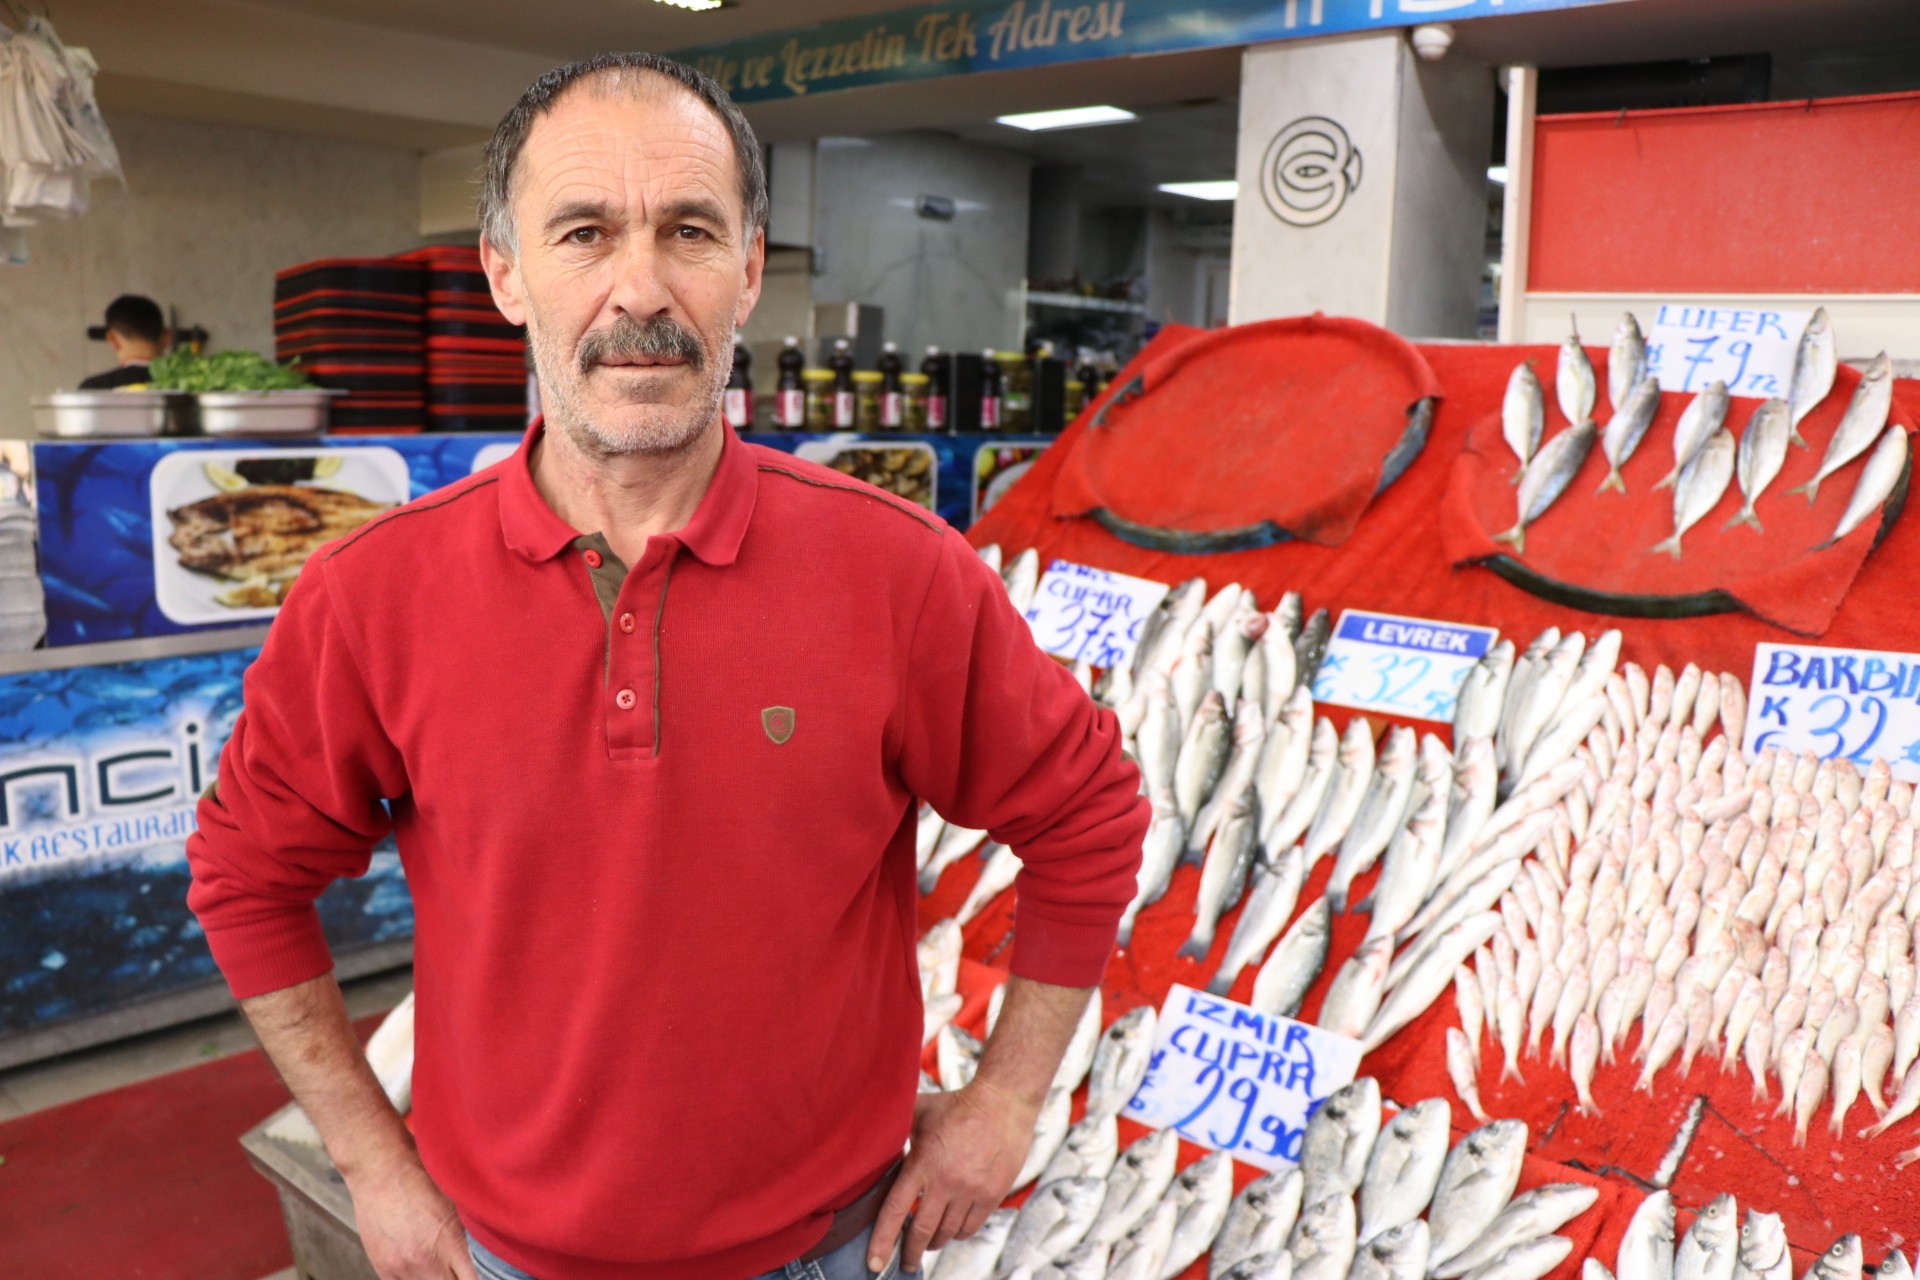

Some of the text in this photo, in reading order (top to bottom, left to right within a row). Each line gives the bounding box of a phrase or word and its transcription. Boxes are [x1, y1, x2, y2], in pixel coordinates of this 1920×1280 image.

[741, 54, 777, 90] ve
[781, 24, 906, 95] Lezzetin
[914, 11, 978, 64] Tek
[987, 0, 1125, 61] Adresi
[1362, 619, 1471, 653] LEVREK
[1761, 650, 1920, 706] BARBU
[1759, 694, 1792, 726] K
[1808, 693, 1890, 766] 32
